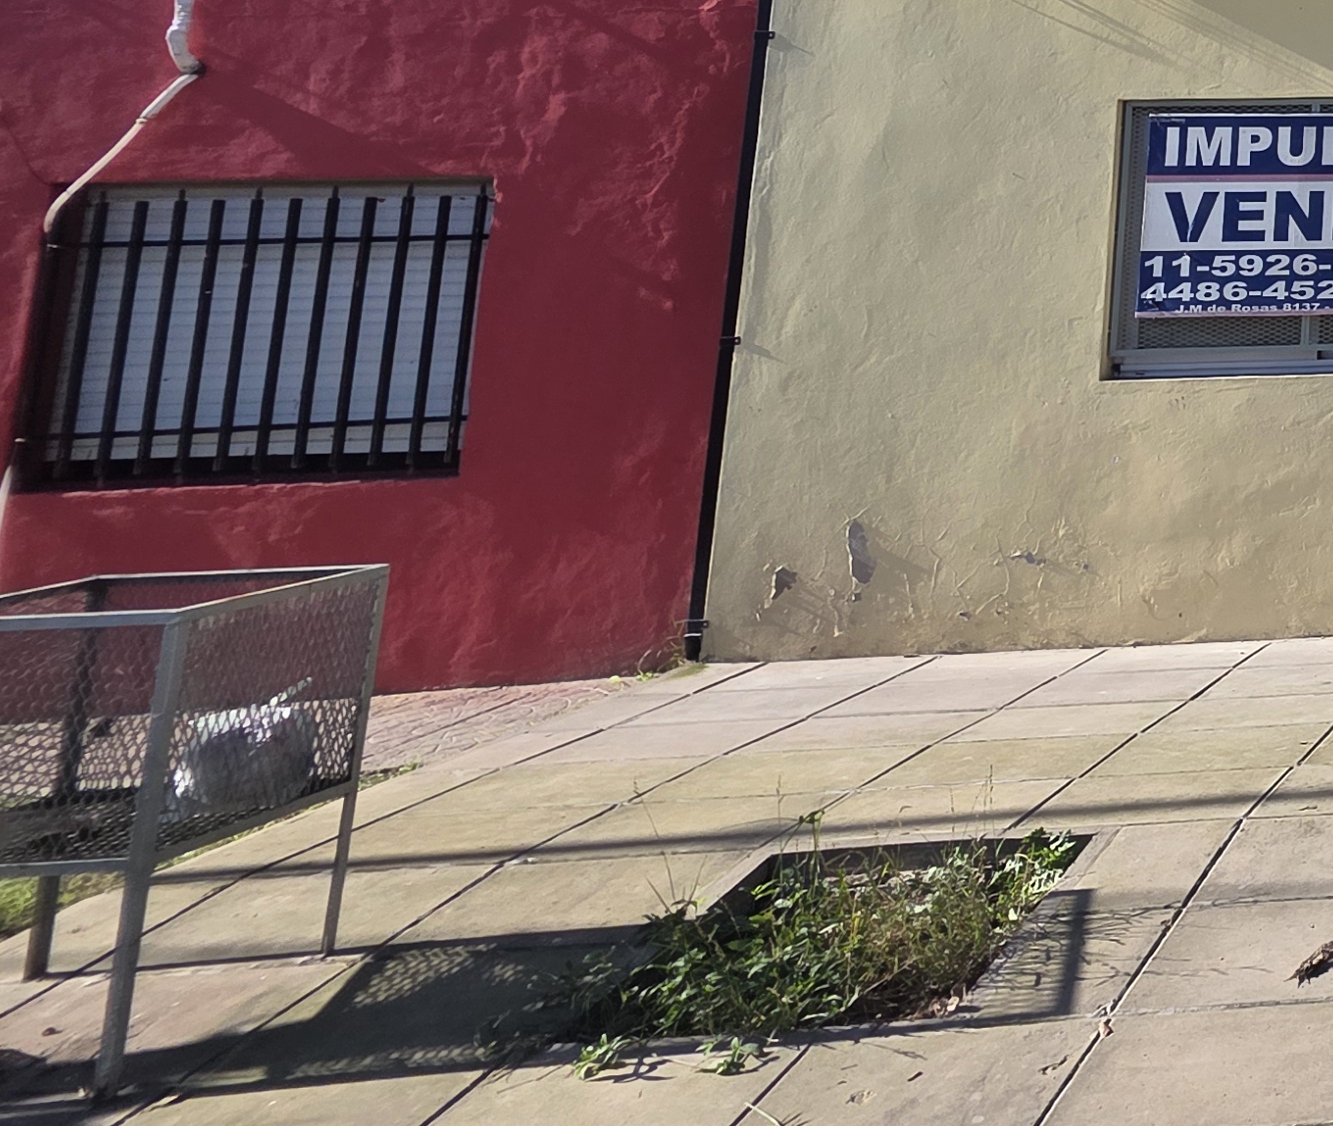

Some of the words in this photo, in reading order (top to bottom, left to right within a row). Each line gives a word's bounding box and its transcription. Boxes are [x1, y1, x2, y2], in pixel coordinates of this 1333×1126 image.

[1207, 303, 1226, 313] de
[1231, 303, 1277, 313] Rosas
[1282, 302, 1321, 312] 8137
